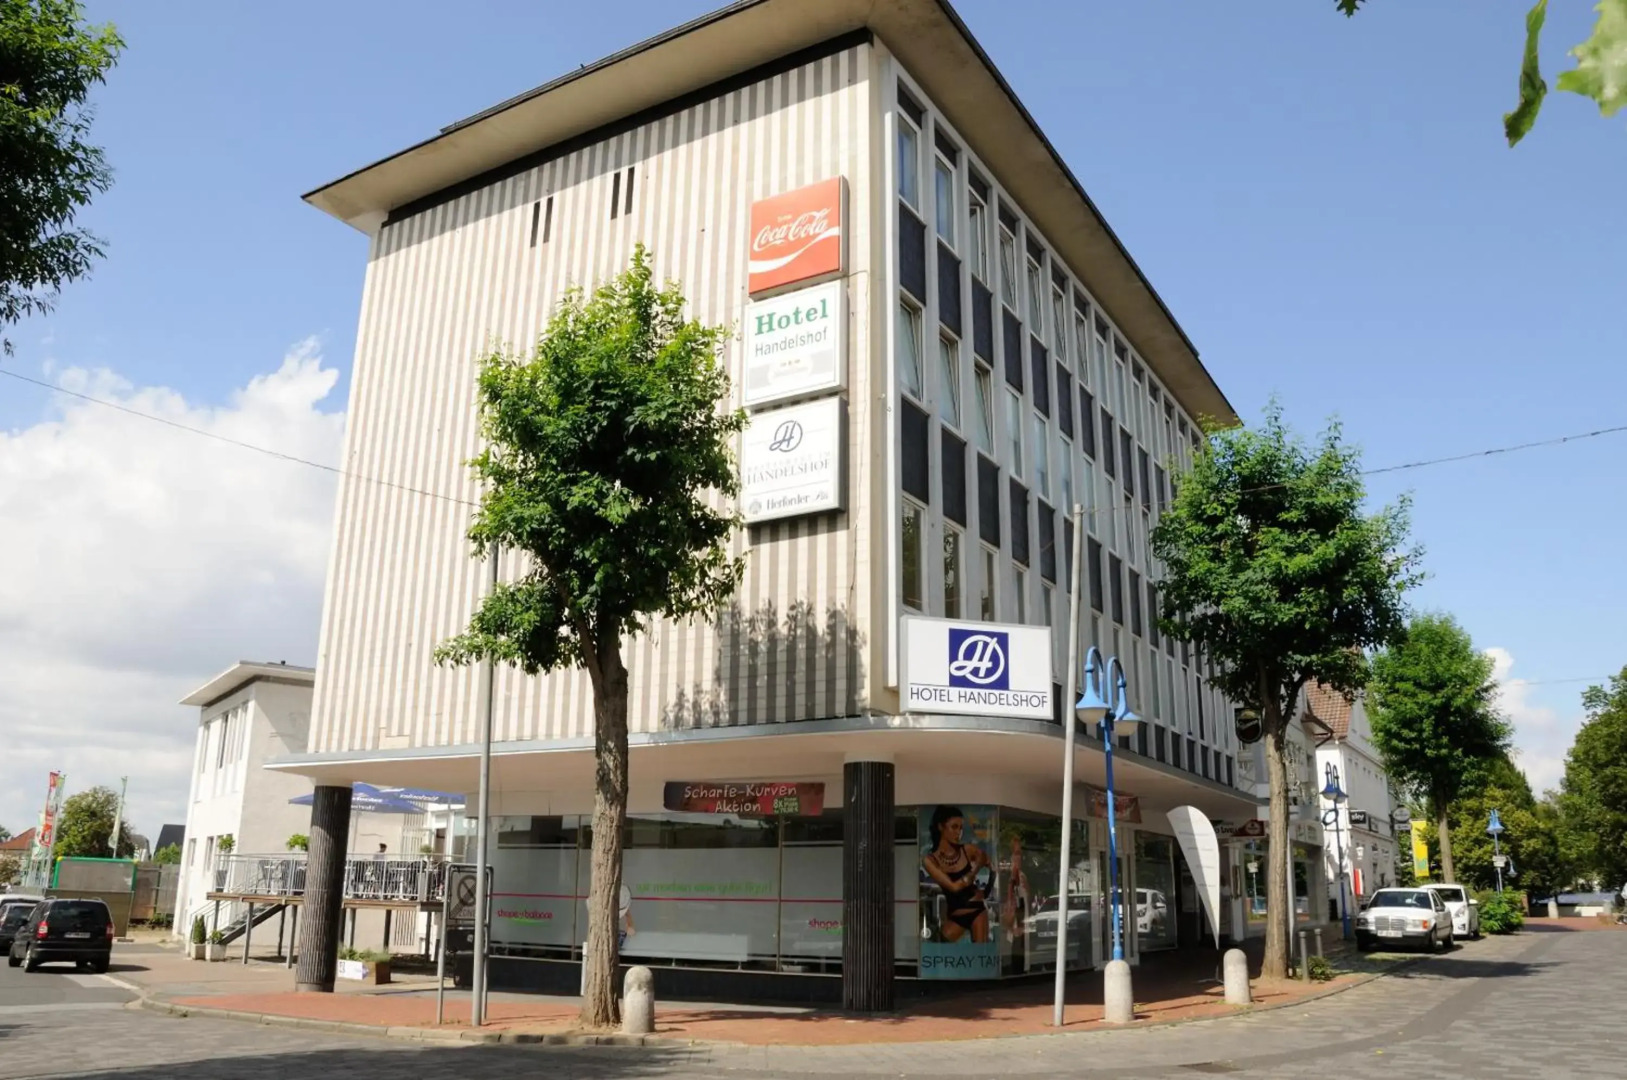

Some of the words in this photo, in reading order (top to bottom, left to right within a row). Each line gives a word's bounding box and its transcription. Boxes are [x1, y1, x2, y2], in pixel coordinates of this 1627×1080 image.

[753, 207, 832, 252] Coca-Cola
[755, 298, 828, 336] Hotel
[755, 326, 828, 357] Handelshof
[747, 458, 830, 486] HANDELSHOF
[910, 687, 953, 703] HOTEL
[958, 690, 1048, 708] HANDELSHOF
[684, 785, 798, 798] Scharfe-Kurven
[714, 799, 762, 813] Aktion
[922, 956, 974, 968] SPRAY
